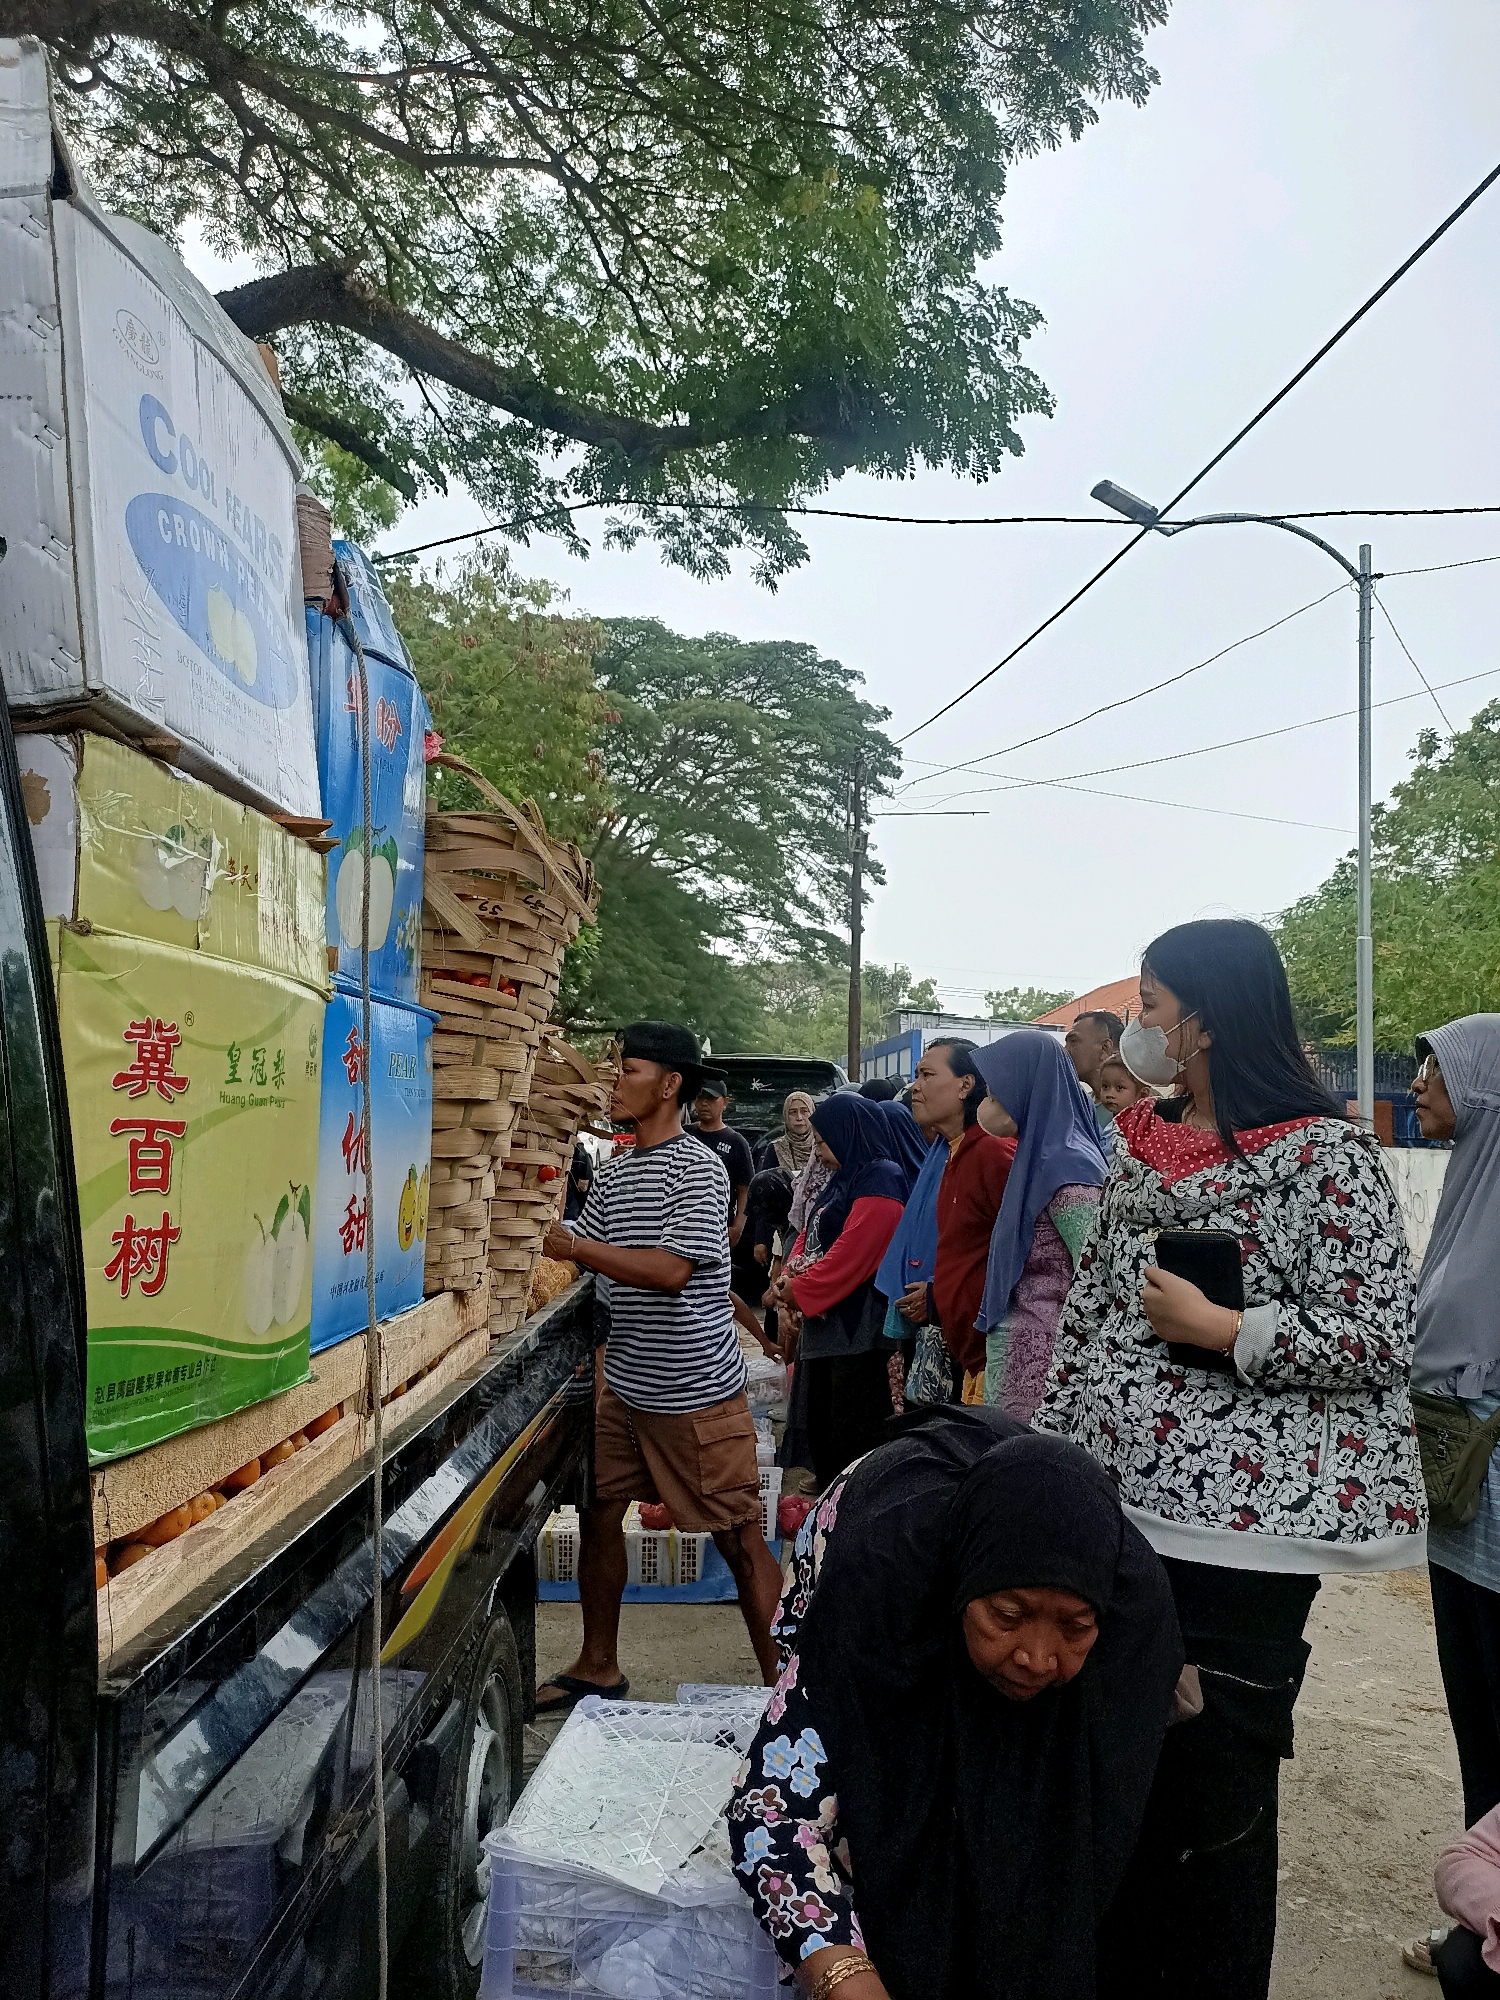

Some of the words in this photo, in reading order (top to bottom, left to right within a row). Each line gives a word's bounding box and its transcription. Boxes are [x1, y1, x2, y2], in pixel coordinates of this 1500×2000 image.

[139, 393, 218, 508] COOL
[225, 486, 285, 595] PEARS
[157, 509, 230, 572] CROWN
[236, 557, 283, 650] PEARS
[219, 1090, 246, 1109] Huang
[248, 1092, 268, 1108] Guan
[225, 1041, 286, 1090] 皇冠梨
[388, 1051, 418, 1080] PEAR
[103, 1015, 190, 1298] 冀百树
